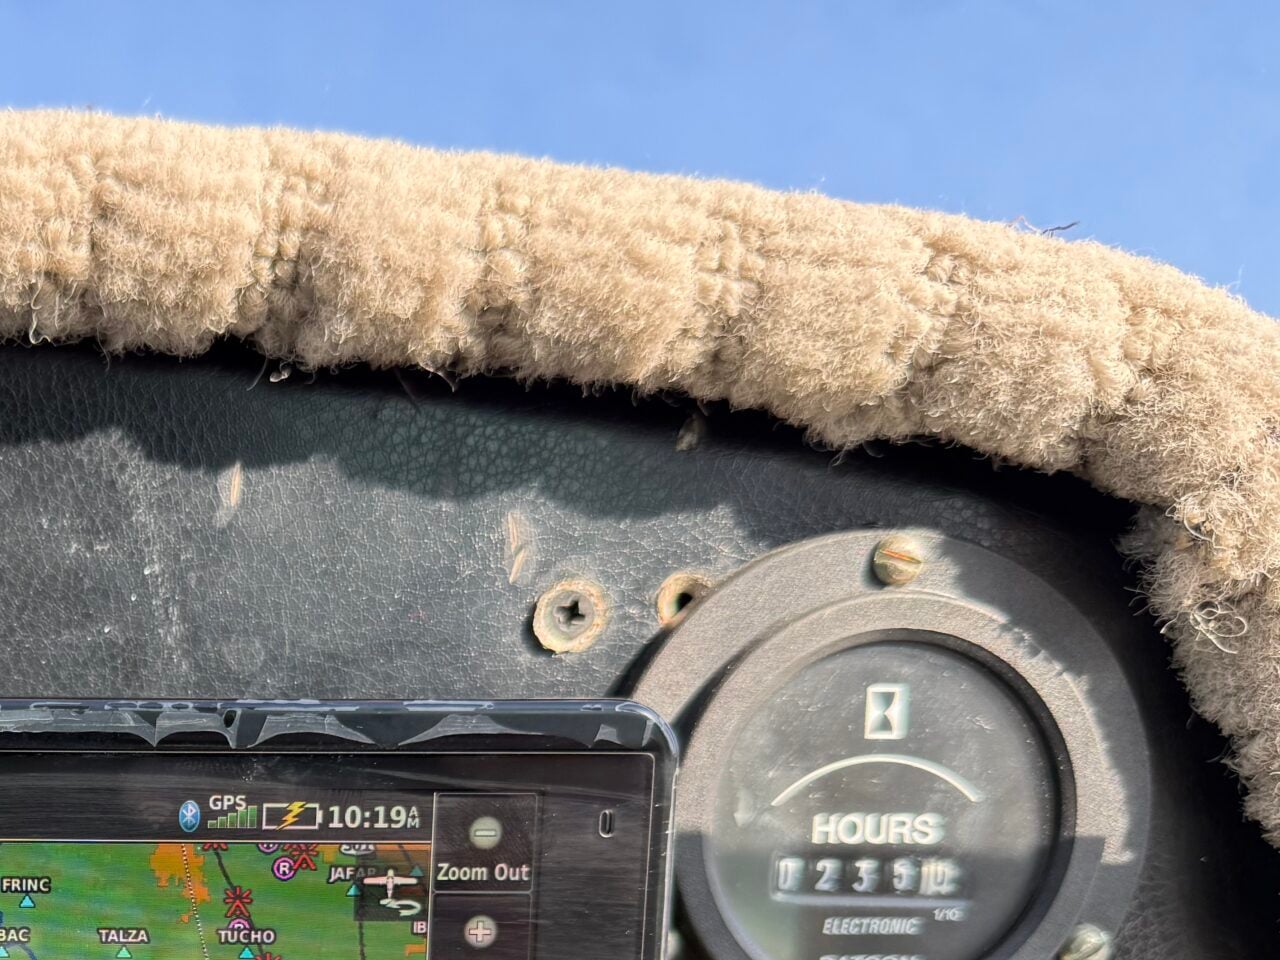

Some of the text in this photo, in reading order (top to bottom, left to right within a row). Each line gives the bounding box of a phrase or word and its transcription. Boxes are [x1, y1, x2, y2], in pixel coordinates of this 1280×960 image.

[209, 795, 247, 811] GPS
[328, 805, 406, 828] 10:19
[811, 813, 944, 844] HOURS
[437, 863, 531, 881] Zoom Out
[2, 879, 50, 892] FRINC
[822, 918, 922, 935] ELECTRONIC
[99, 931, 148, 943] TALZA
[219, 931, 275, 943] TUCHO
